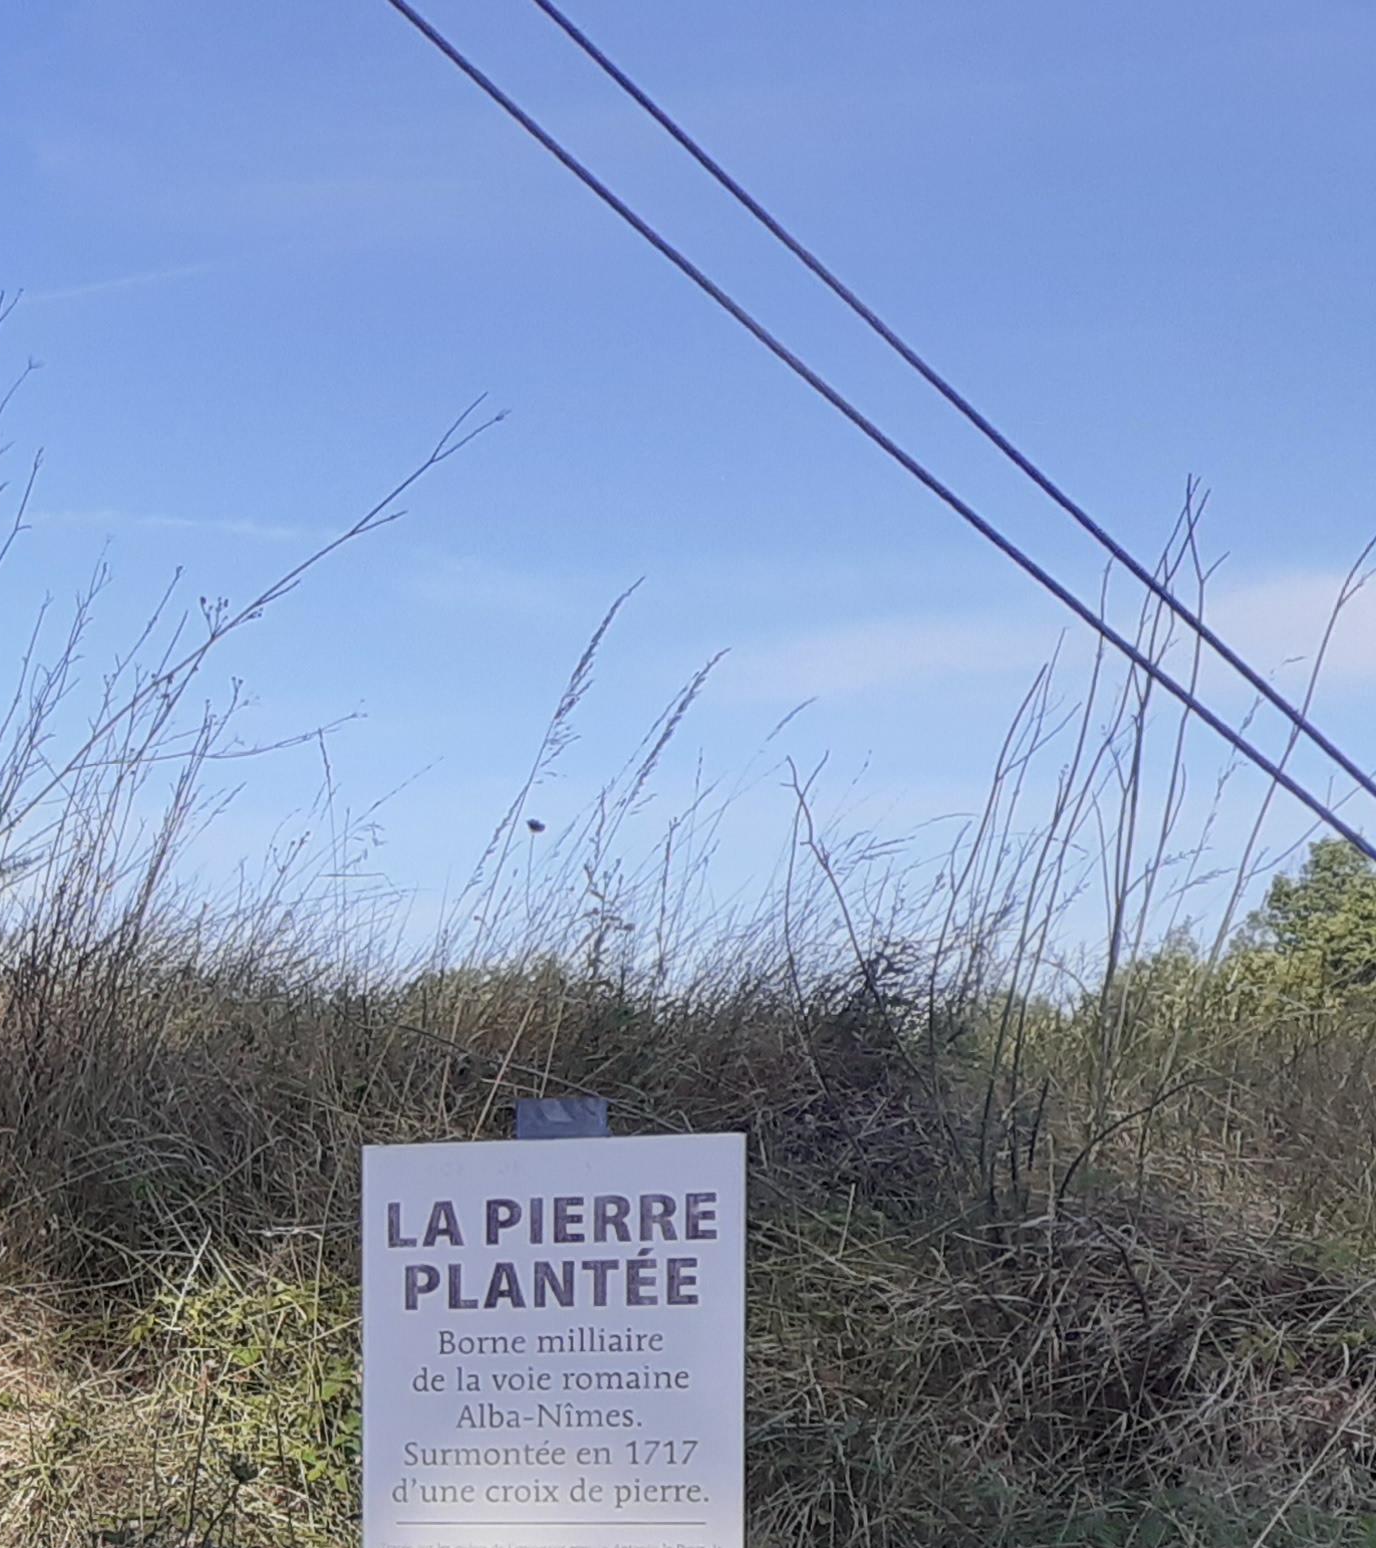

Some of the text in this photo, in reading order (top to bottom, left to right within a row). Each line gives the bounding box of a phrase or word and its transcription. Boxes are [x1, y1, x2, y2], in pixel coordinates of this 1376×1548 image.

[388, 1192, 717, 1248] LA PIERRE
[404, 1248, 698, 1310] PLANTÉE
[438, 1327, 663, 1355] Borne milliaire
[412, 1365, 689, 1392] de la voie romaine
[456, 1402, 642, 1428] Alba-Nîmes.
[403, 1440, 698, 1466] Surmontée en 1717
[486, 1478, 559, 1503] croix
[570, 1477, 603, 1502] de
[614, 1478, 709, 1508] pierre.
